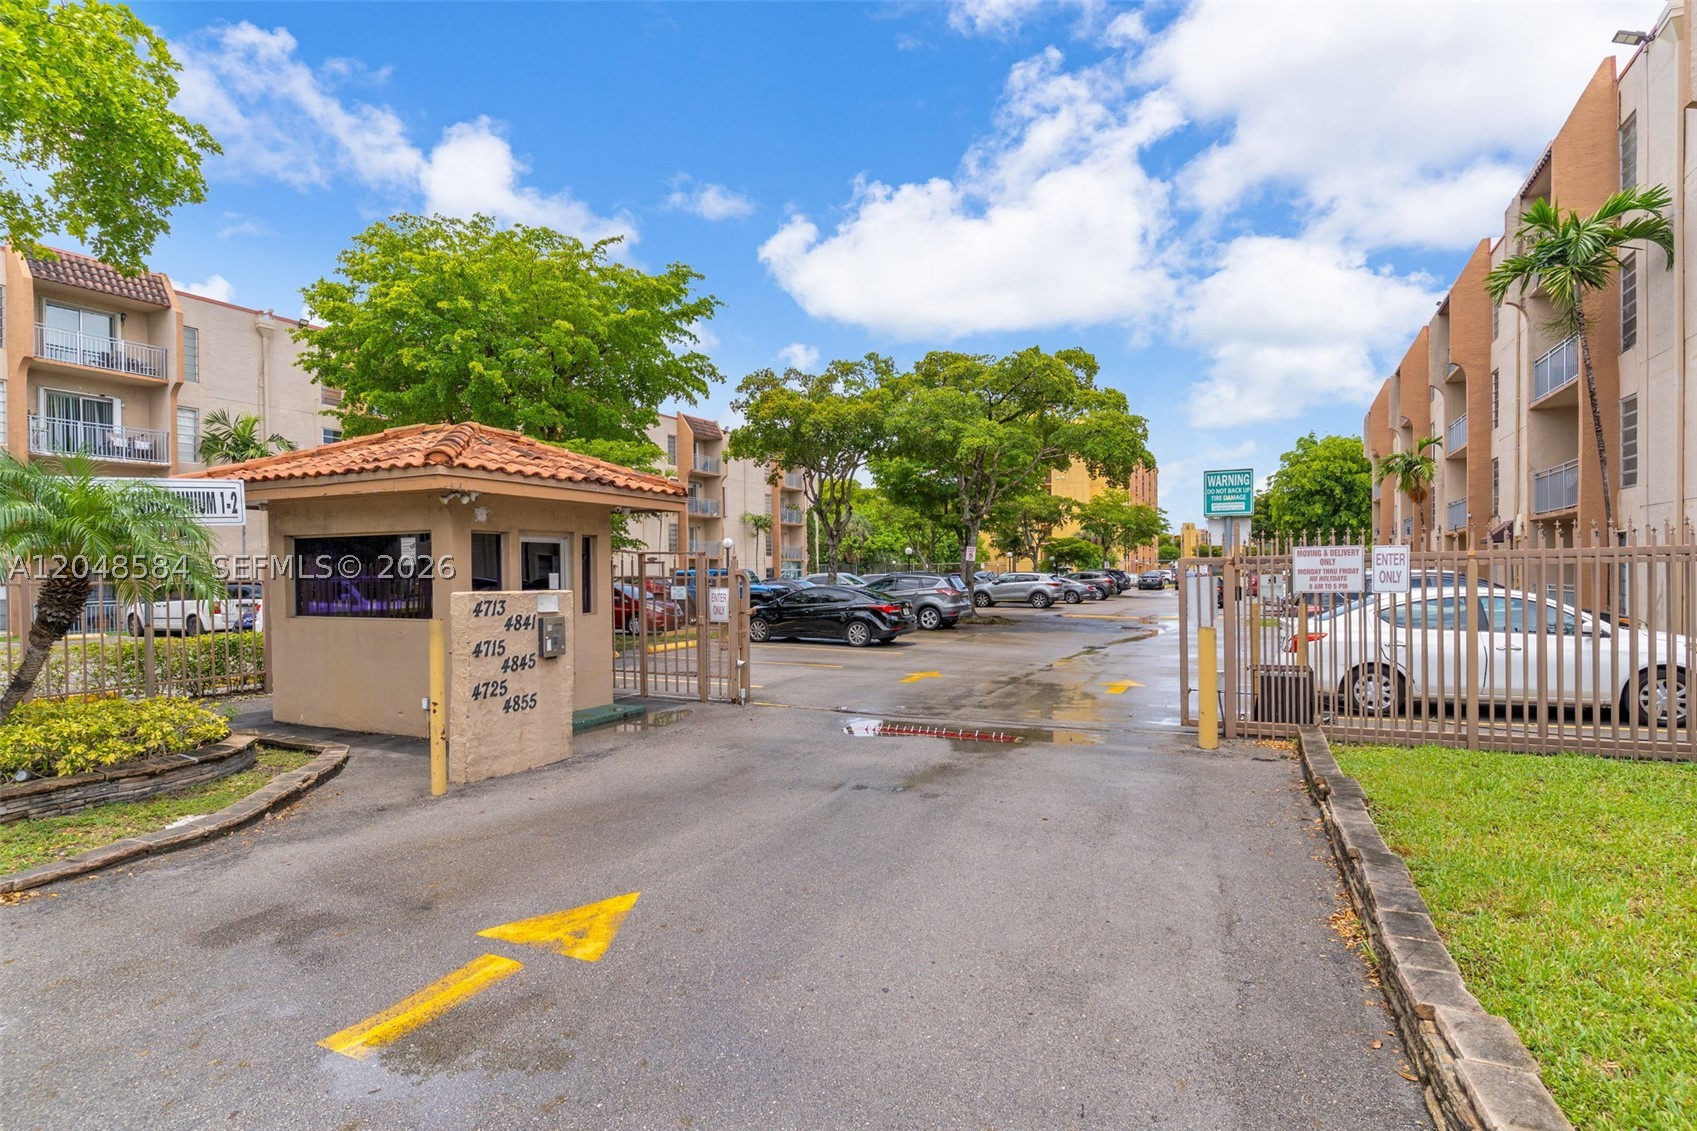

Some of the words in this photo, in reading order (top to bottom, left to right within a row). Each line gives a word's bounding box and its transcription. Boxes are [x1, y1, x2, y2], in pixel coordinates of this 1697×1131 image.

[1207, 474, 1250, 487] WARNING
[220, 491, 238, 514] 1-2
[1297, 549, 1321, 557] MOVING
[1323, 549, 1328, 557] &
[1330, 548, 1360, 557] DELIVERY
[1376, 553, 1406, 566] ENTER
[1320, 558, 1336, 566] ONLY
[1379, 570, 1402, 583] ONLY
[711, 593, 727, 603] ENTER
[472, 600, 506, 618] 4713
[712, 605, 725, 615] ONLY
[504, 614, 536, 631] 4841
[472, 639, 506, 658] 4715
[501, 653, 536, 673] 4845
[471, 679, 508, 701] 4725
[502, 692, 537, 714] 4855
